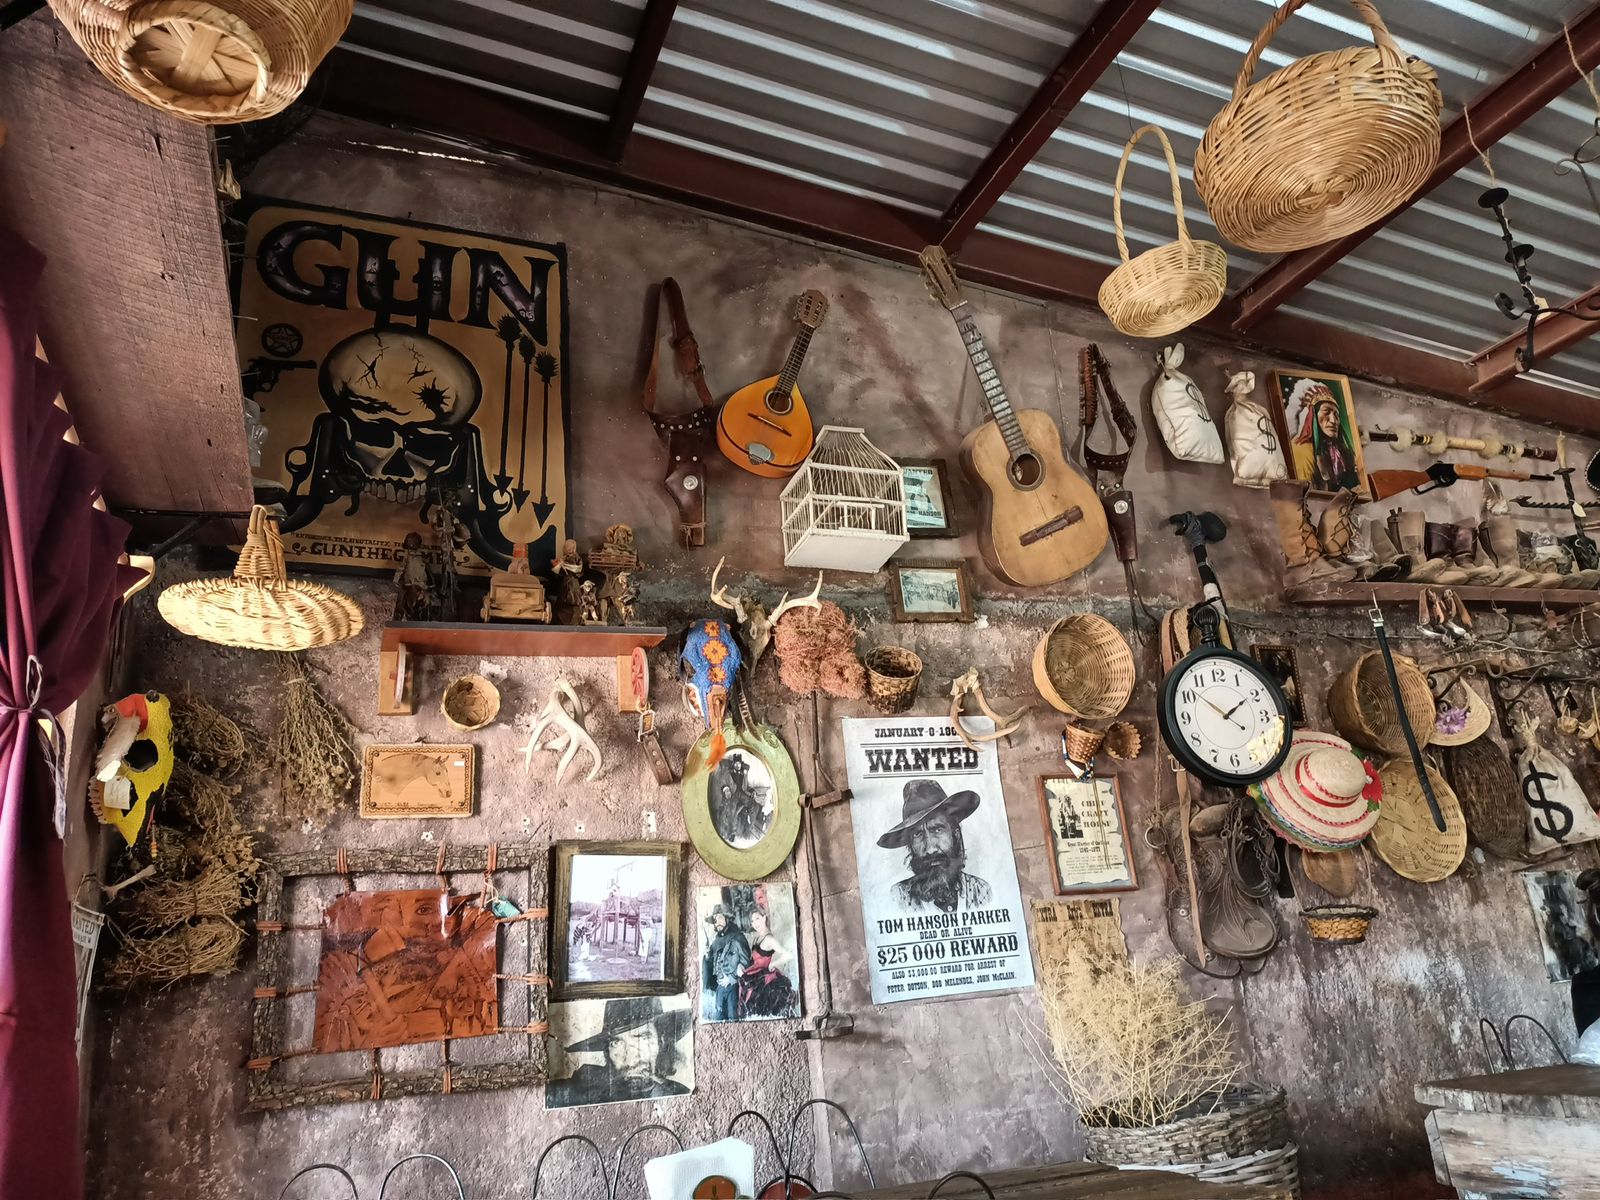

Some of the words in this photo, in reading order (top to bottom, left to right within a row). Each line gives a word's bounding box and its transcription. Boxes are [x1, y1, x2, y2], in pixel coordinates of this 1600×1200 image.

[256, 219, 559, 347] GUN
[309, 542, 444, 565] GUNTHEGME
[1194, 673, 1205, 687] 11
[1211, 668, 1226, 683] 12
[1234, 673, 1240, 687] 1
[1182, 689, 1196, 704] 10
[1250, 688, 1261, 703] 2
[1181, 711, 1192, 726] 9
[1259, 709, 1270, 724] 3
[1190, 732, 1202, 748] 8
[865, 746, 979, 774] WANTED
[1210, 748, 1219, 763] 7
[1230, 753, 1241, 768] 6
[877, 918, 904, 935] TOM
[907, 912, 959, 932] HANSON
[962, 908, 1011, 926] PARKER
[919, 931, 938, 940] DEAD
[941, 929, 951, 938] OR
[953, 927, 973, 936] ALIVE
[877, 946, 908, 967] $25
[912, 941, 946, 962] 000
[950, 935, 1018, 958] REWARD
[892, 970, 906, 980] ALSO
[941, 965, 963, 975] REWARD
[964, 963, 975, 972] FOR
[977, 961, 997, 970] ARREST
[887, 985, 905, 994] PETER
[976, 974, 990, 984] JOHN
